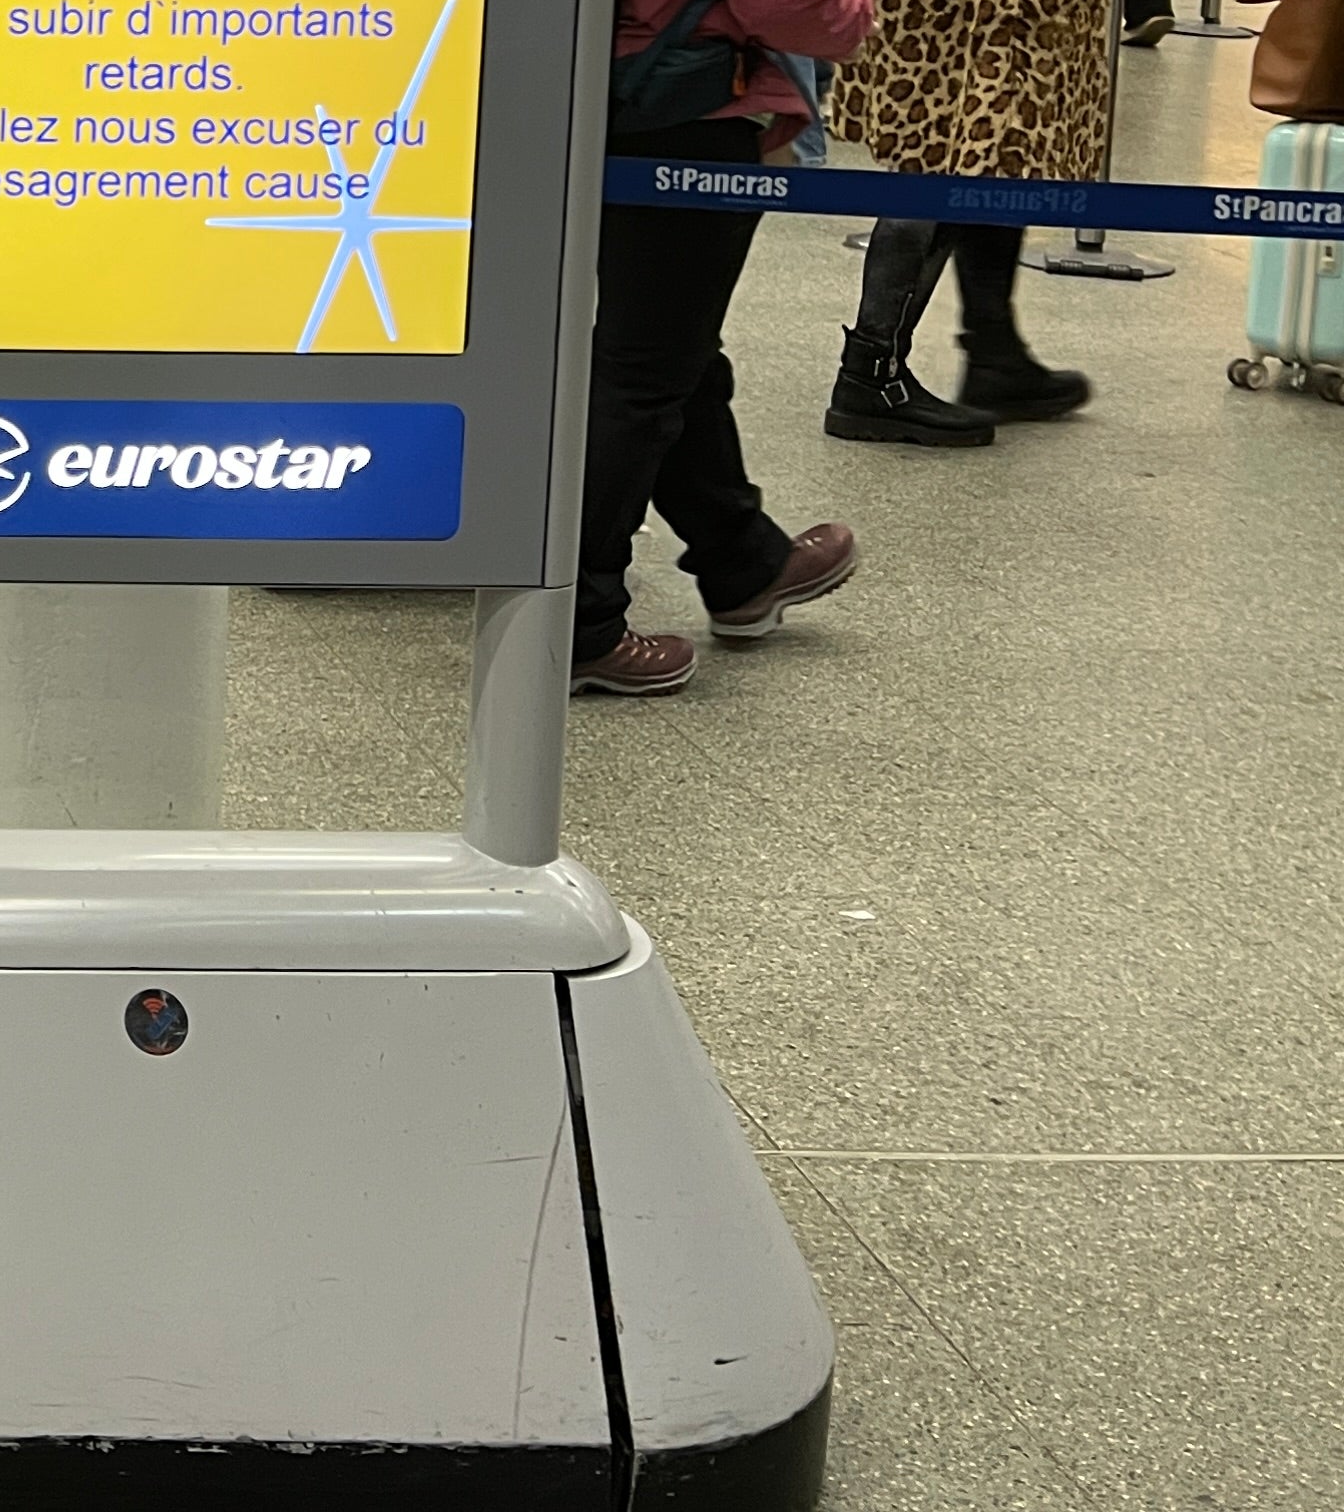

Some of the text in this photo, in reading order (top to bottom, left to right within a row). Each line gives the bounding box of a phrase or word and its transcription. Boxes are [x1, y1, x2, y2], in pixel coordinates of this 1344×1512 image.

[8, 0, 114, 36] subir
[84, 54, 245, 92] retards.
[74, 116, 177, 146] nous
[191, 117, 363, 147] excuser
[373, 110, 427, 148] du
[244, 171, 372, 201] cause
[47, 437, 372, 492] eurostar
